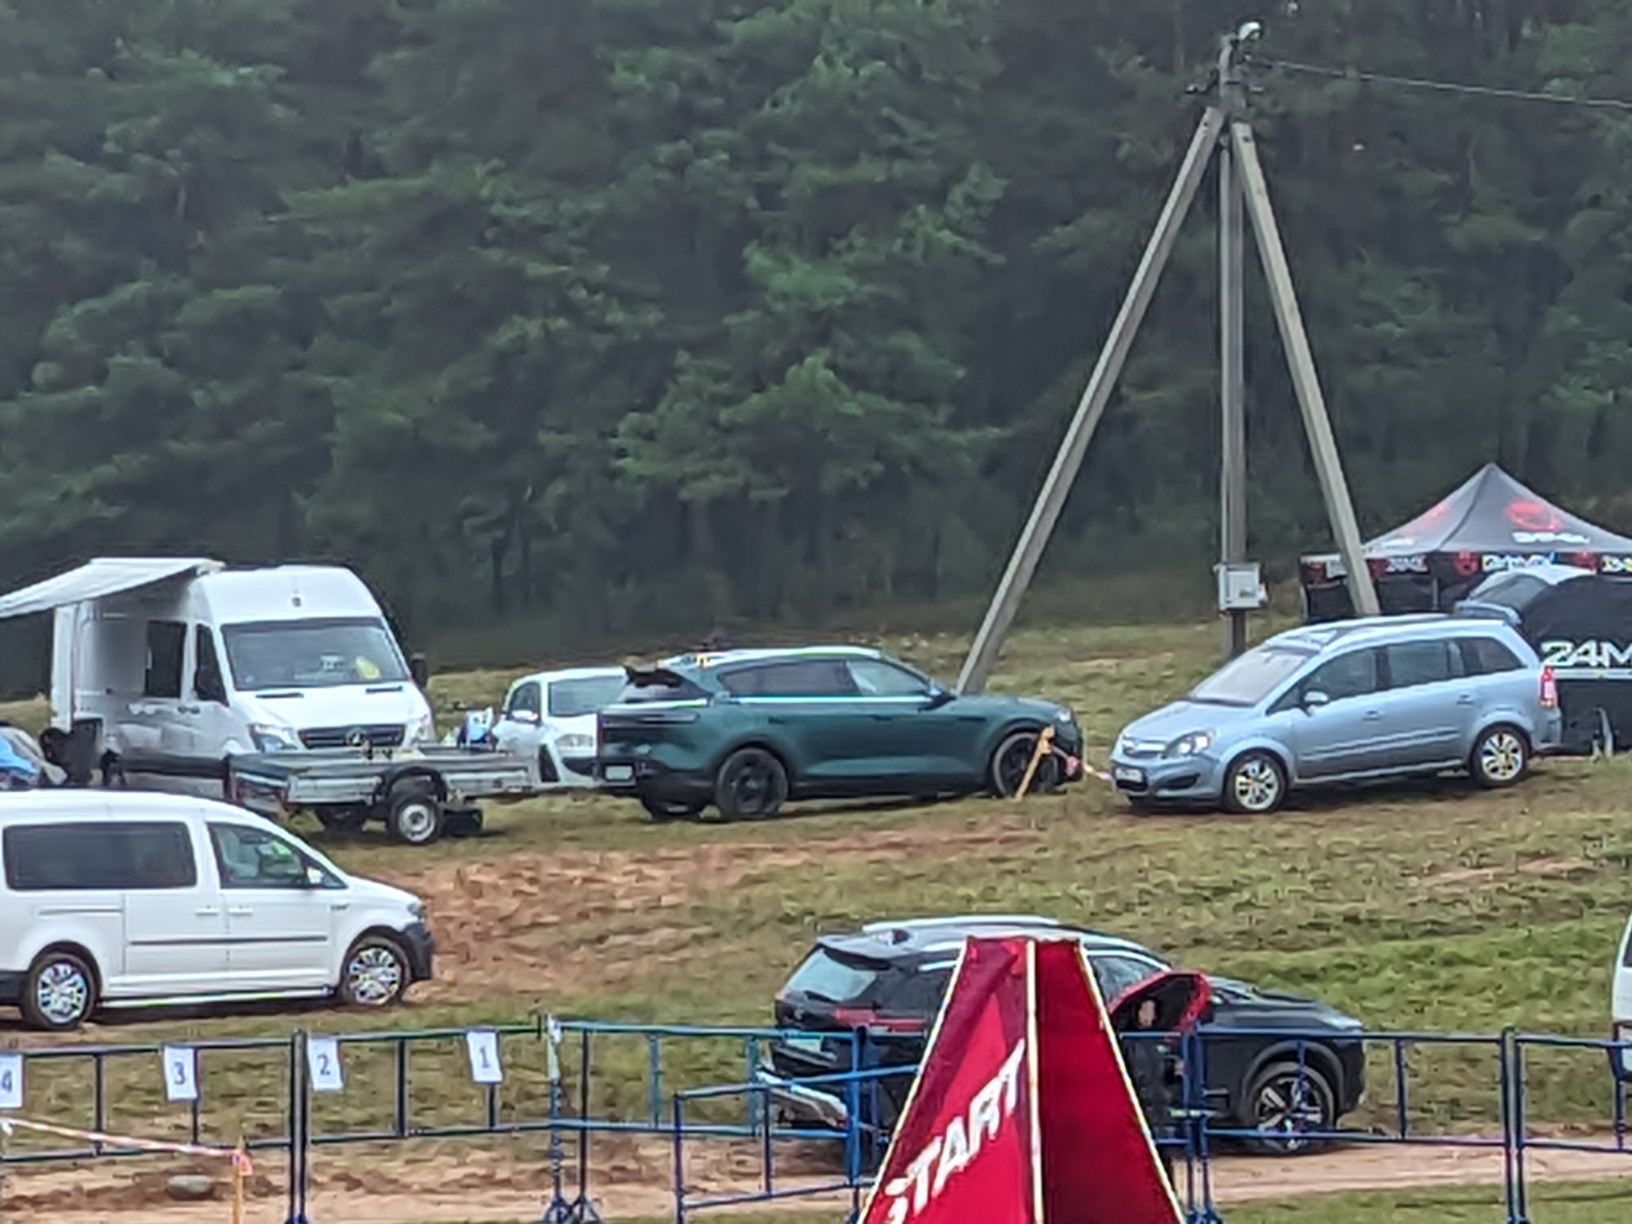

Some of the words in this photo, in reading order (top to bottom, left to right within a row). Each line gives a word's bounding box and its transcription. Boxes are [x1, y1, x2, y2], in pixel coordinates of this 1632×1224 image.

[318, 1052, 331, 1077] 2
[480, 1047, 489, 1069] 1
[1, 1069, 12, 1093] 4
[174, 1061, 187, 1084] 3
